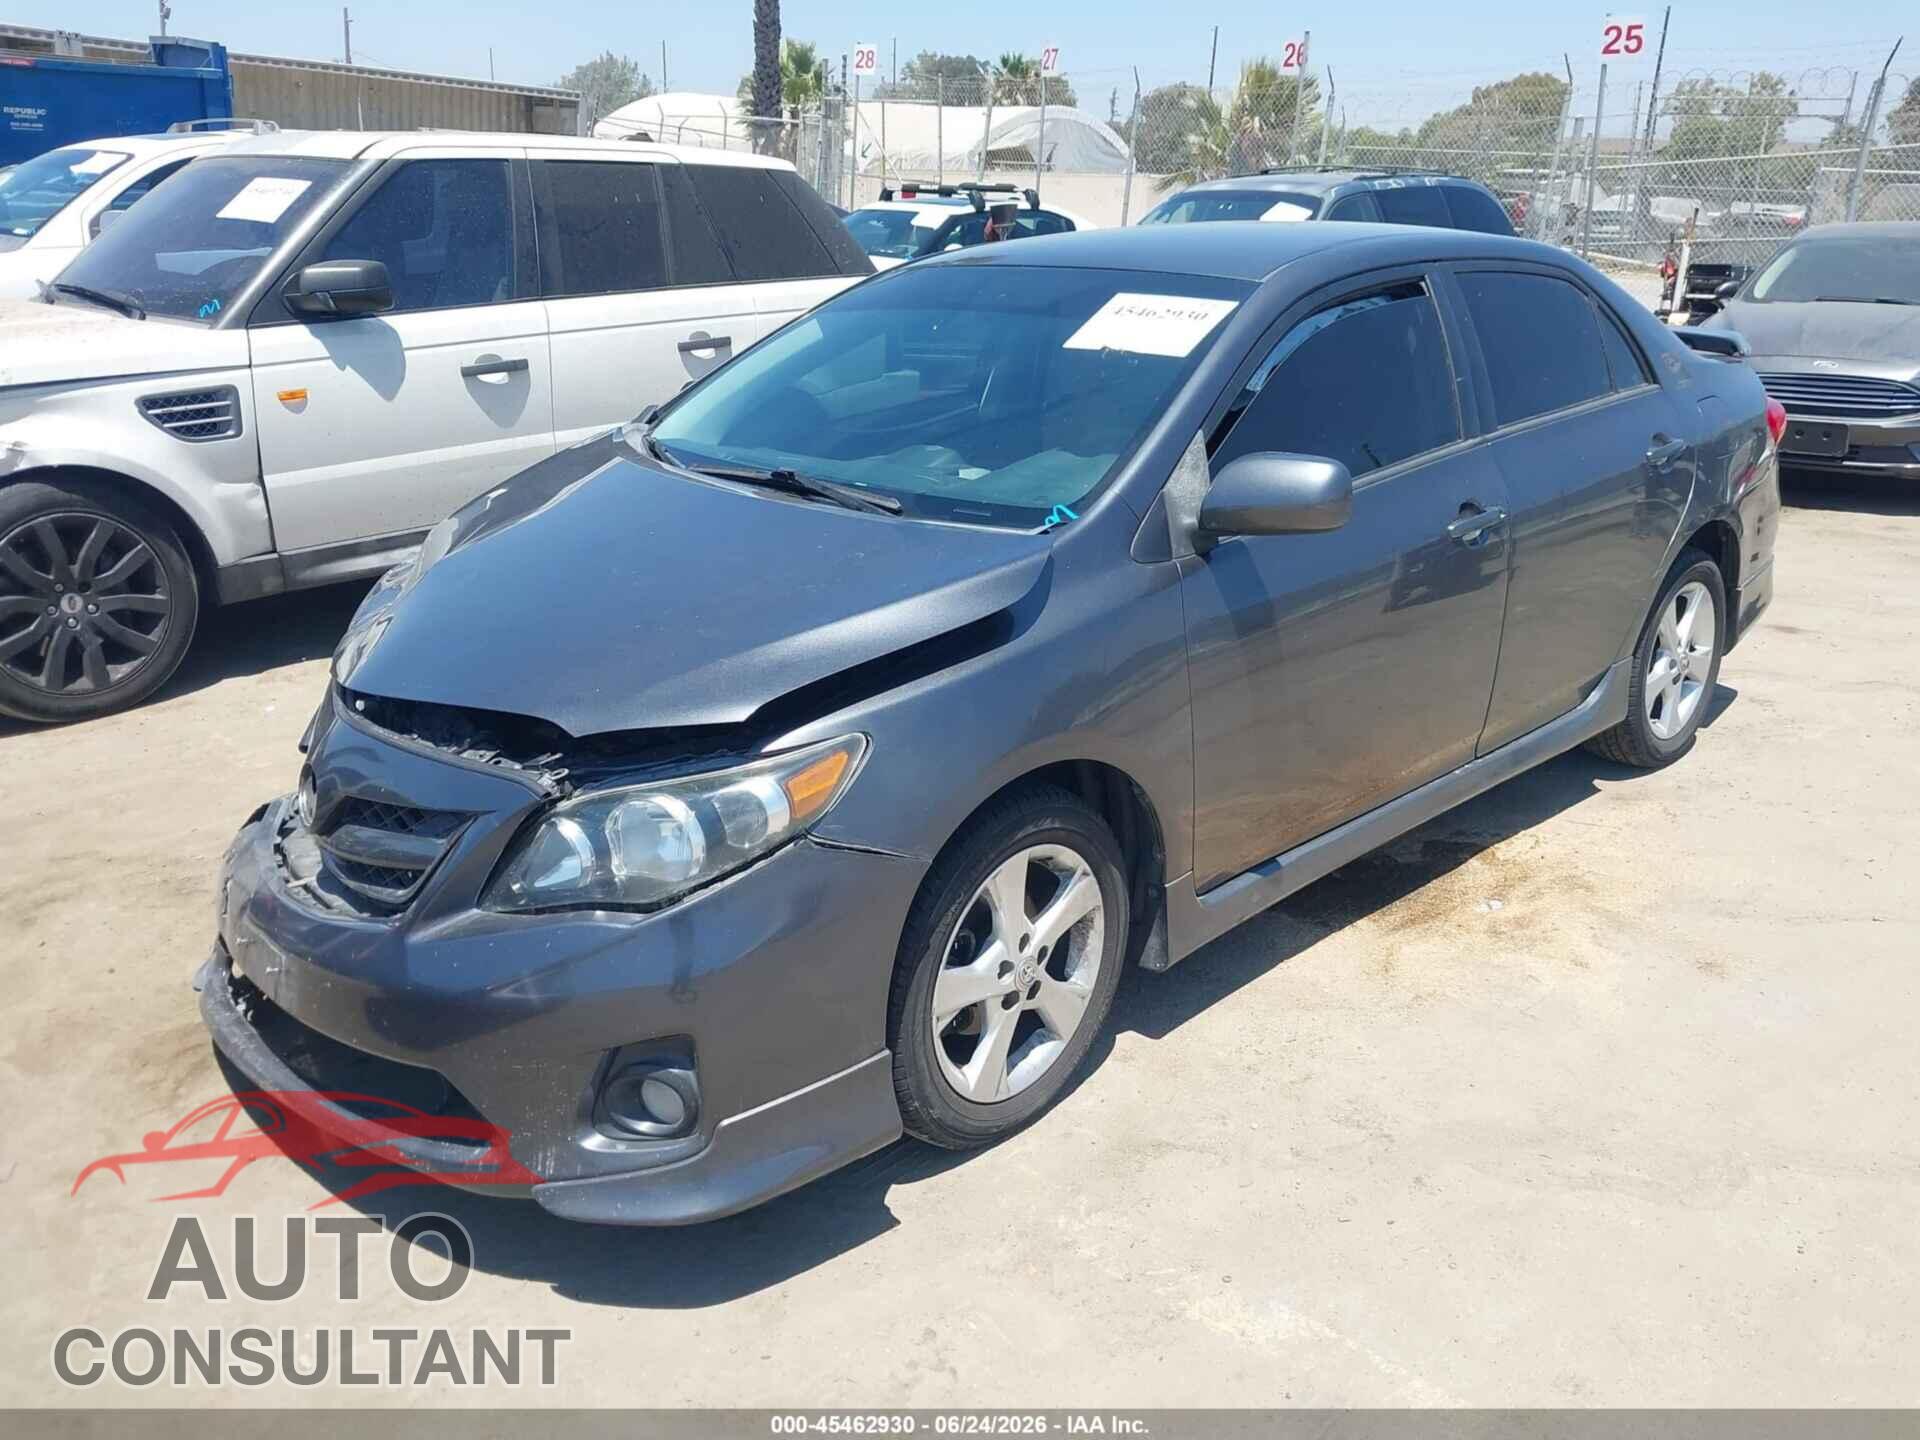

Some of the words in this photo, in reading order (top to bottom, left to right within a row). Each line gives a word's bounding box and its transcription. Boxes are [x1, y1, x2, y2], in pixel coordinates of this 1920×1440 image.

[1602, 24, 1643, 54] 25
[855, 50, 874, 69] 28
[1043, 48, 1059, 70] 27
